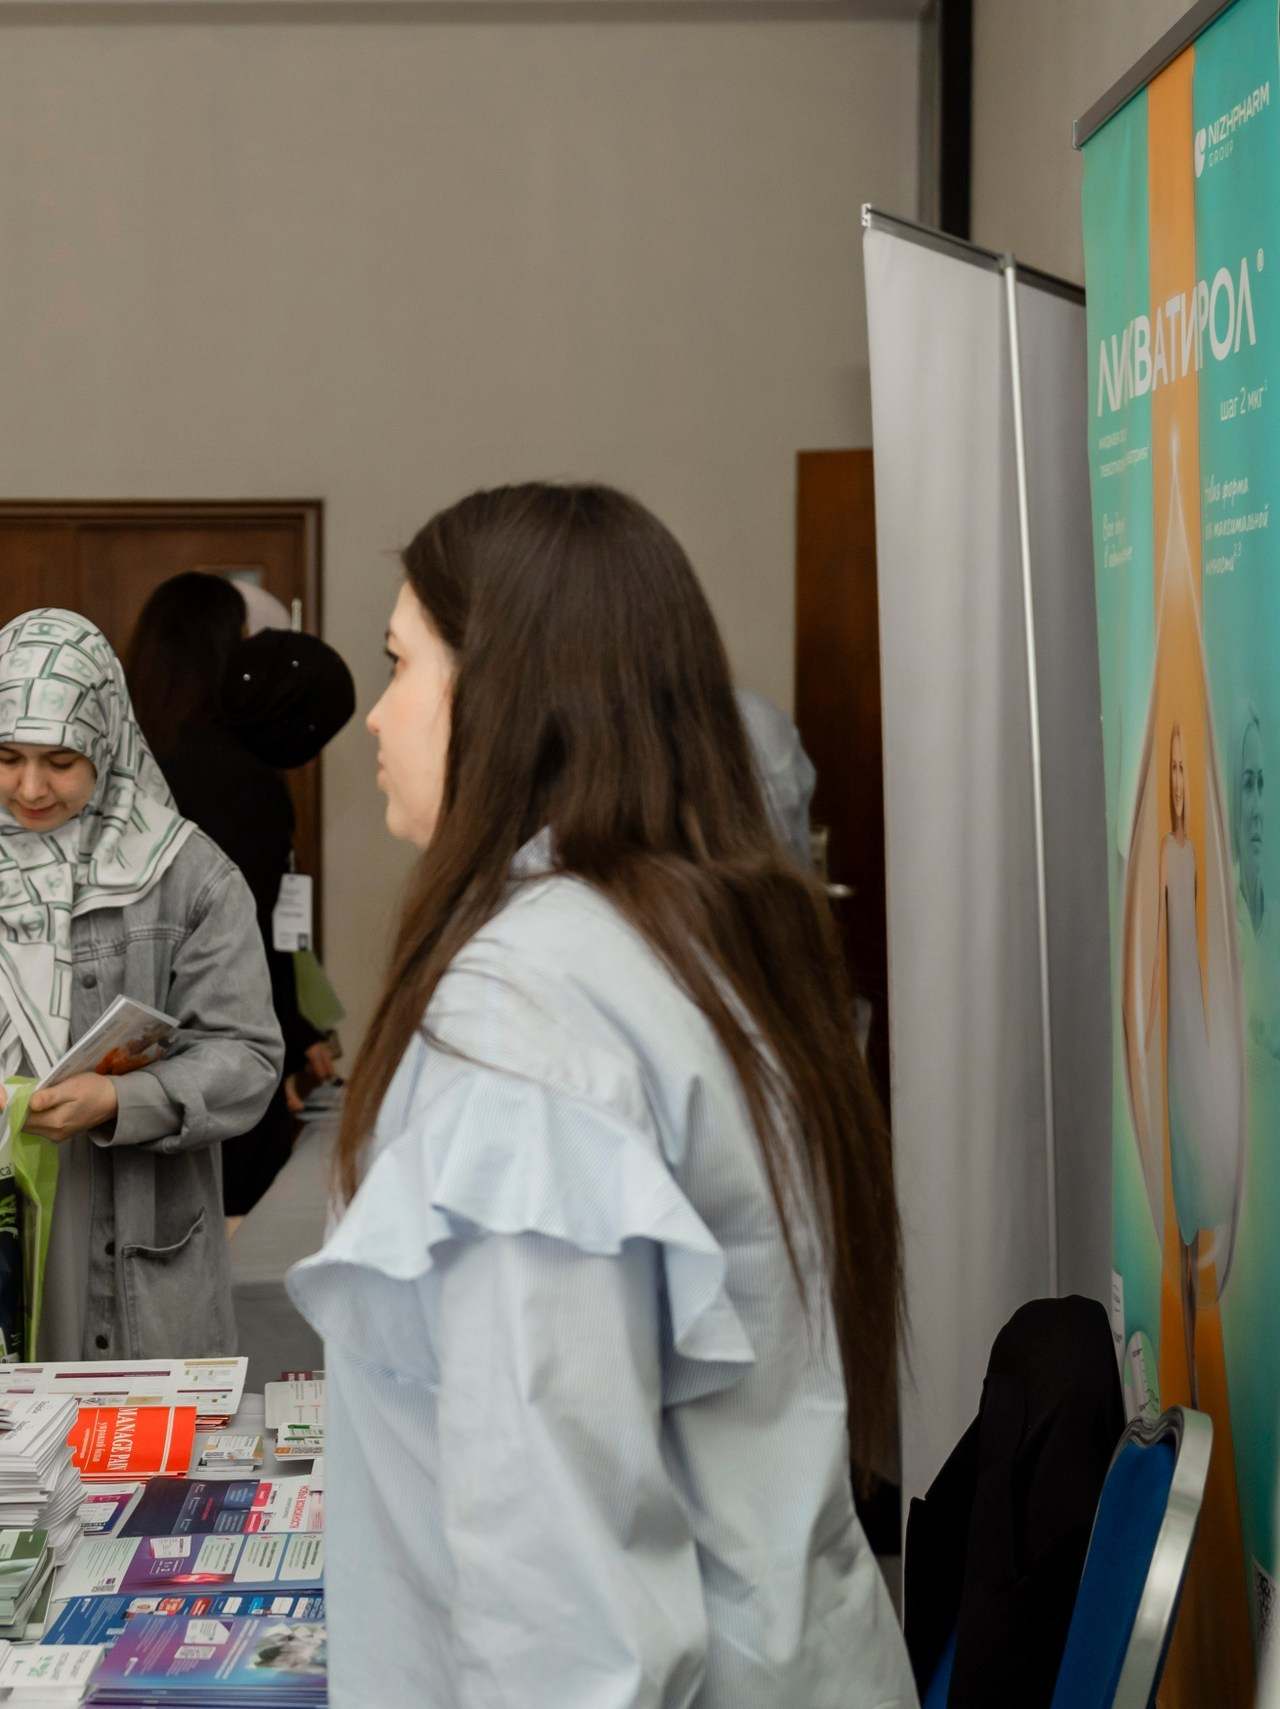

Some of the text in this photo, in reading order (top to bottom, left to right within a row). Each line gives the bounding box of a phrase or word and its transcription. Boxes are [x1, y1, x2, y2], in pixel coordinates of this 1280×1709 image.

[1208, 81, 1269, 148] NIZHPHARM
[1220, 396, 1239, 421] шаг
[1239, 387, 1247, 415] 2
[106, 1407, 138, 1471] MANAGE PAIN
